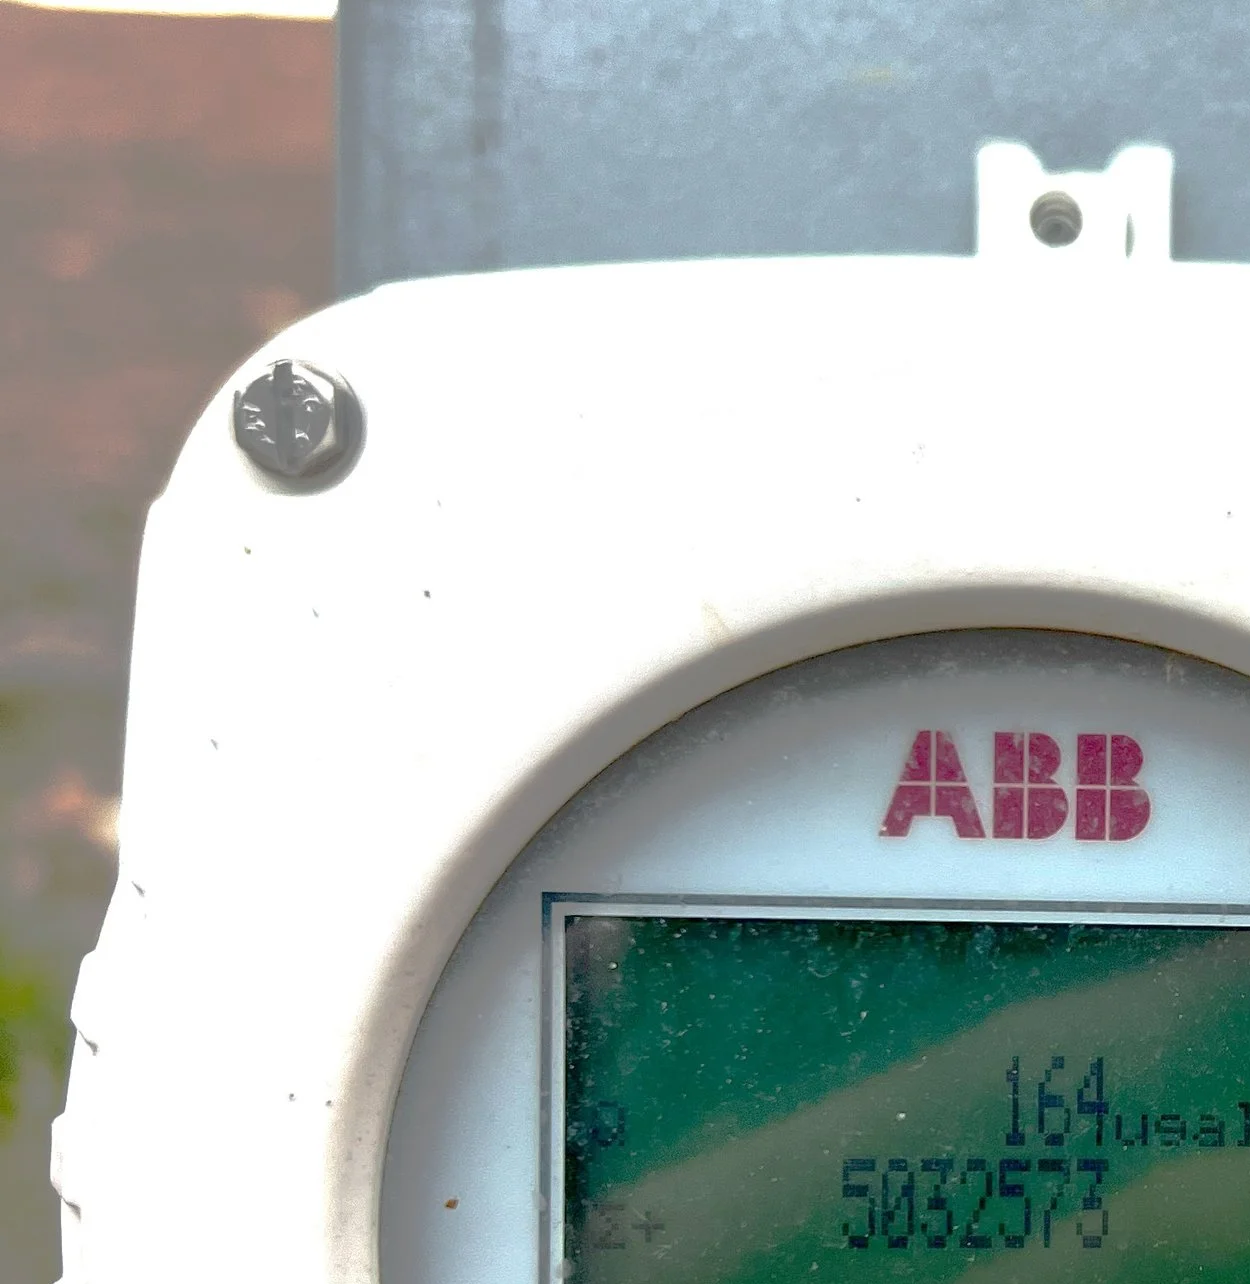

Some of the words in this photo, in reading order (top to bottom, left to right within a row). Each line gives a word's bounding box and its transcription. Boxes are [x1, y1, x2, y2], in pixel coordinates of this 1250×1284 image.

[878, 729, 1152, 841] ABB
[1006, 1055, 1109, 1147] 164
[842, 1159, 1109, 1248] 5032573
